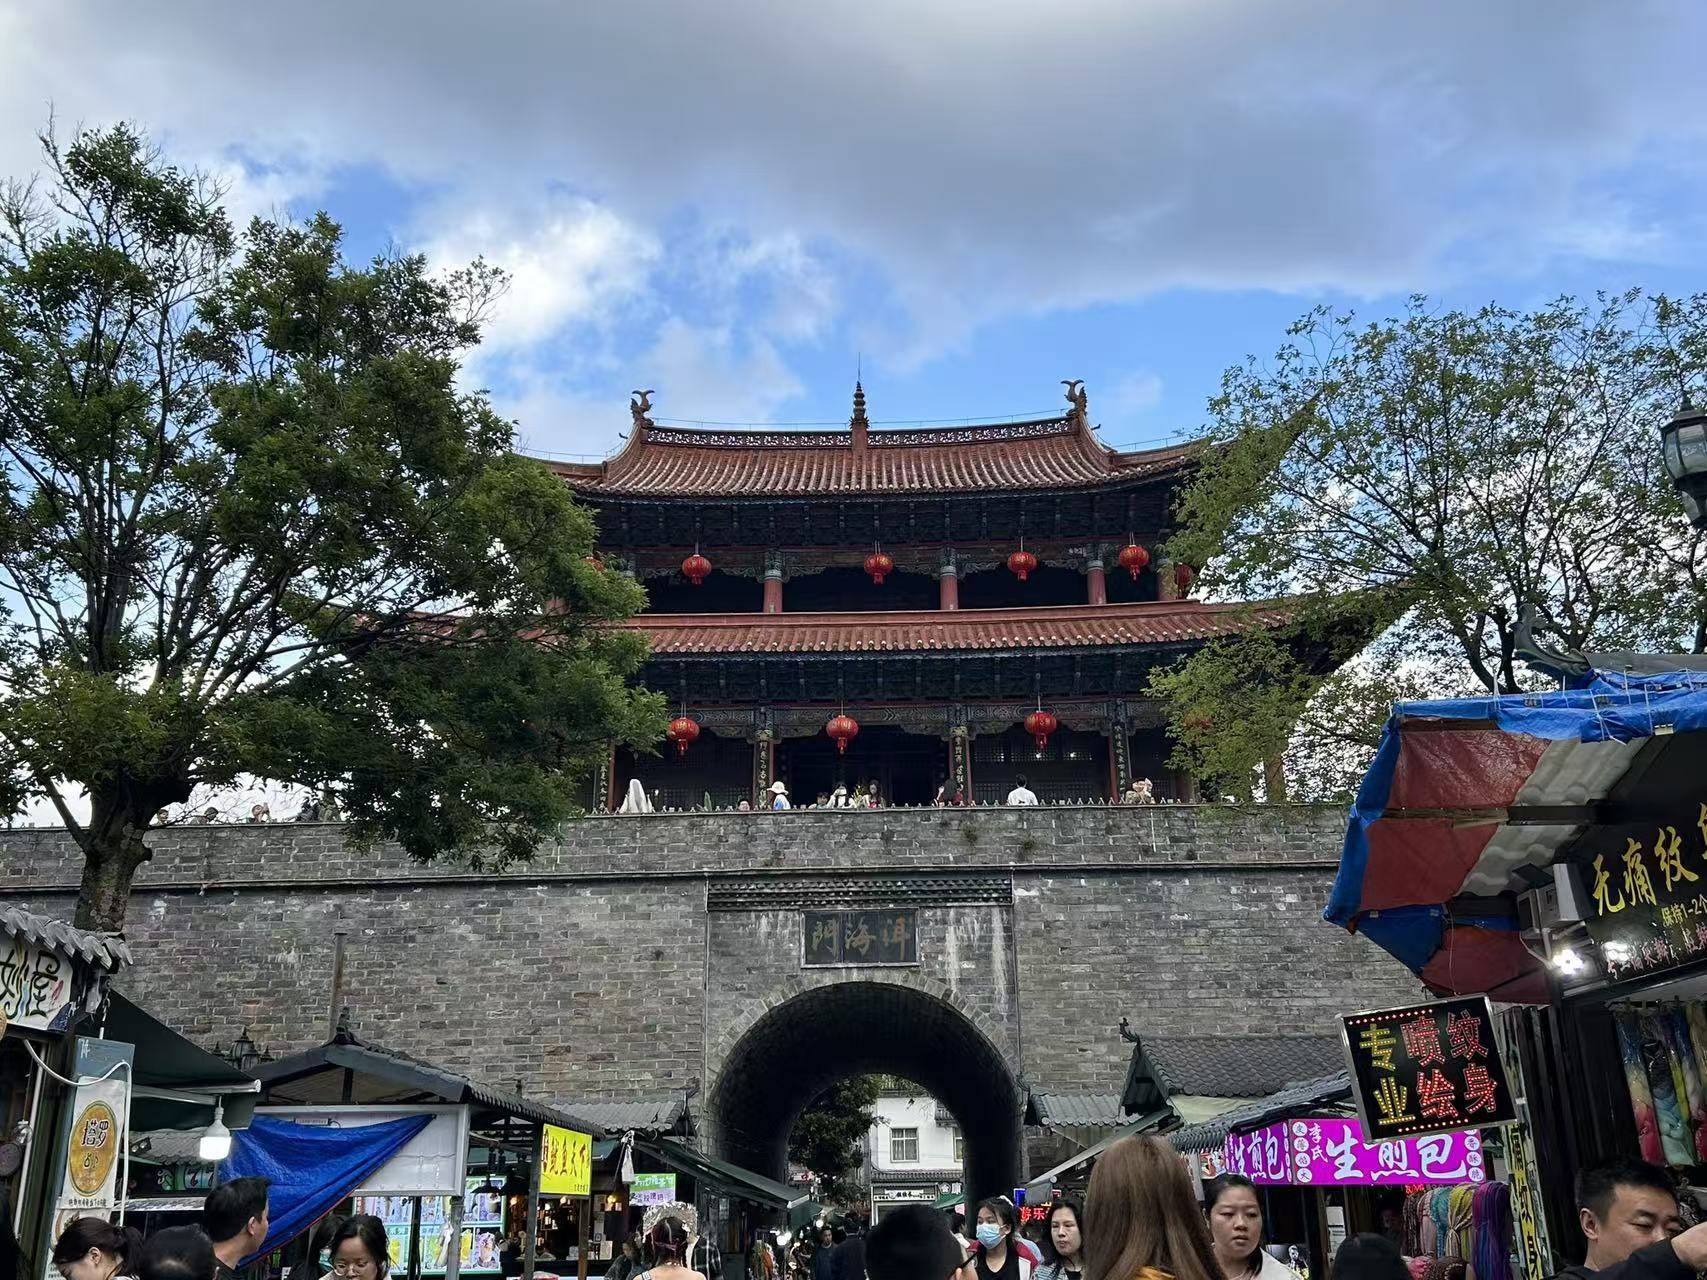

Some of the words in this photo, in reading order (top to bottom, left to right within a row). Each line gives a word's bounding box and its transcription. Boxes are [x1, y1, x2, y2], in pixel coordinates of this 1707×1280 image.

[1359, 1022, 1415, 1126] 专业
[1400, 1014, 1459, 1119] 喷绘
[1446, 1008, 1498, 1115] 纹身
[1308, 1122, 1329, 1163] 李氏
[1326, 1124, 1466, 1182] 生煎包
